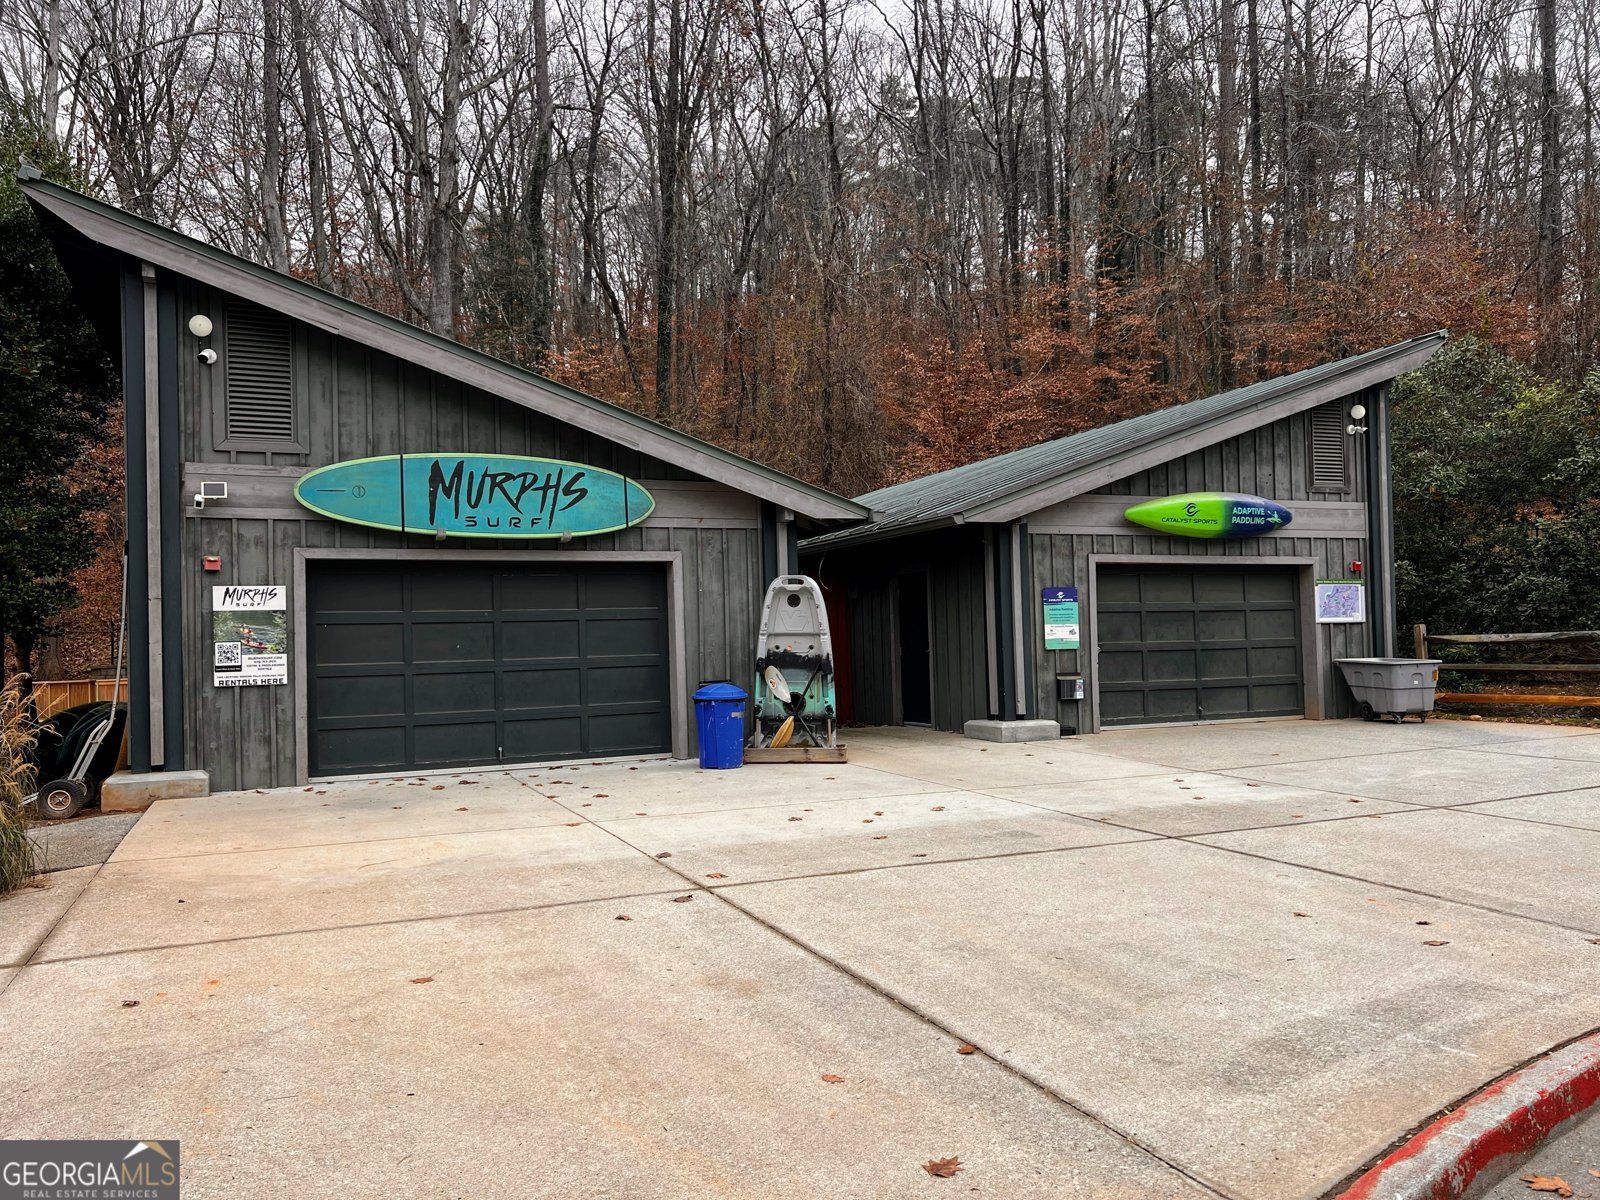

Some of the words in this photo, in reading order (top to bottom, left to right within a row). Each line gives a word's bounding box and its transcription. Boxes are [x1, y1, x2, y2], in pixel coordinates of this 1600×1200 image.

[429, 459, 588, 529] MURPHS
[1232, 507, 1265, 515] ADAPTIVE
[465, 515, 543, 529] SURF
[1231, 516, 1265, 524] PADDLING
[222, 587, 277, 606] MURPHS
